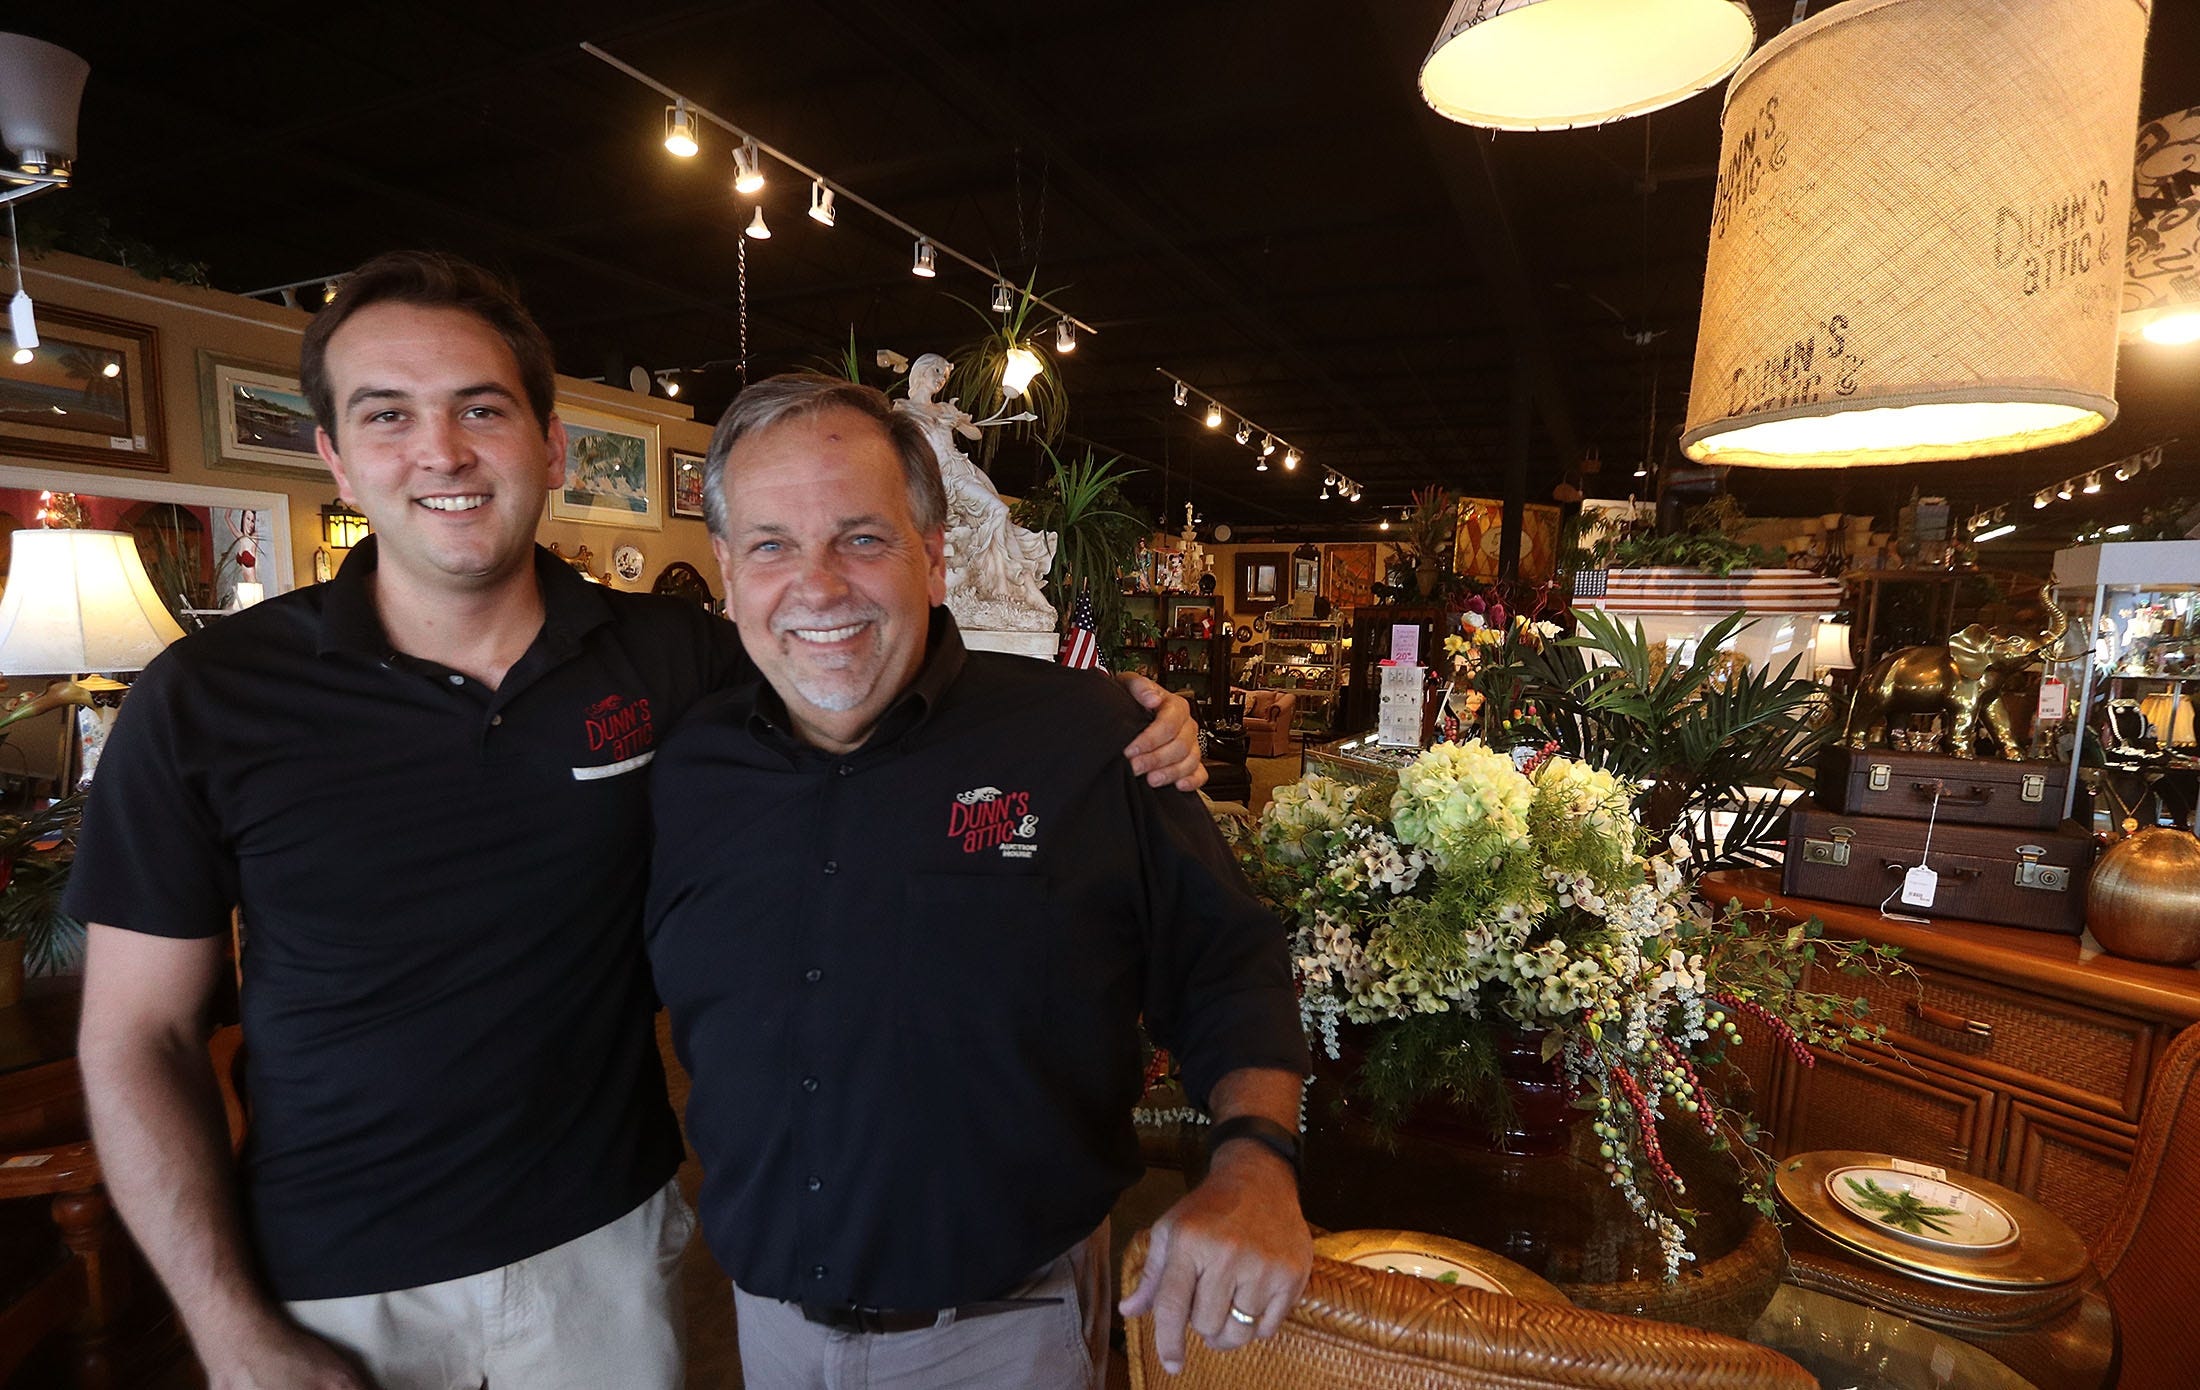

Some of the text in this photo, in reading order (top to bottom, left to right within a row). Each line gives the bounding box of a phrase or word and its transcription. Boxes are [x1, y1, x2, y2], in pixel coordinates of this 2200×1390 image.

[1994, 179, 2109, 270] DUNN'S
[1727, 314, 1848, 418] DUNN'S
[585, 698, 652, 752] DUNN'S
[947, 791, 1030, 838] DUNN'S
